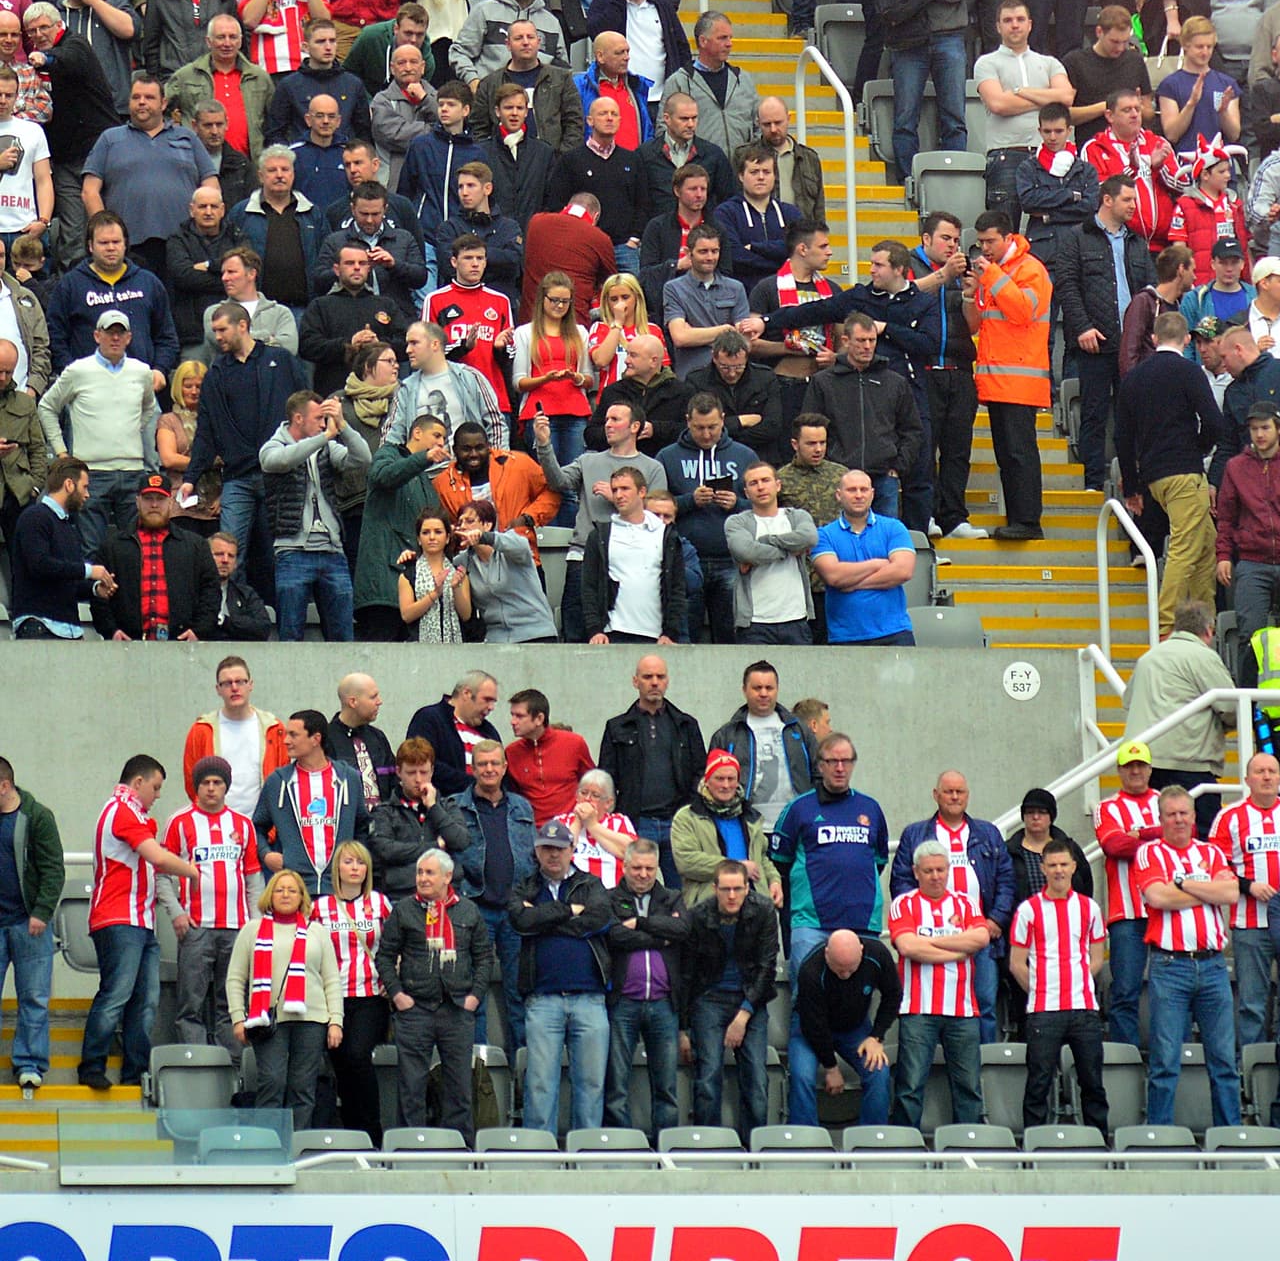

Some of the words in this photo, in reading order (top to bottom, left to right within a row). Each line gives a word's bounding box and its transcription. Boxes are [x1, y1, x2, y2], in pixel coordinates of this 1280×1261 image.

[678, 459, 738, 481] WLLS
[1012, 683, 1032, 693] 537
[836, 826, 858, 835] INVEST
[835, 833, 869, 845] AFRICA
[208, 851, 238, 861] AFRICA
